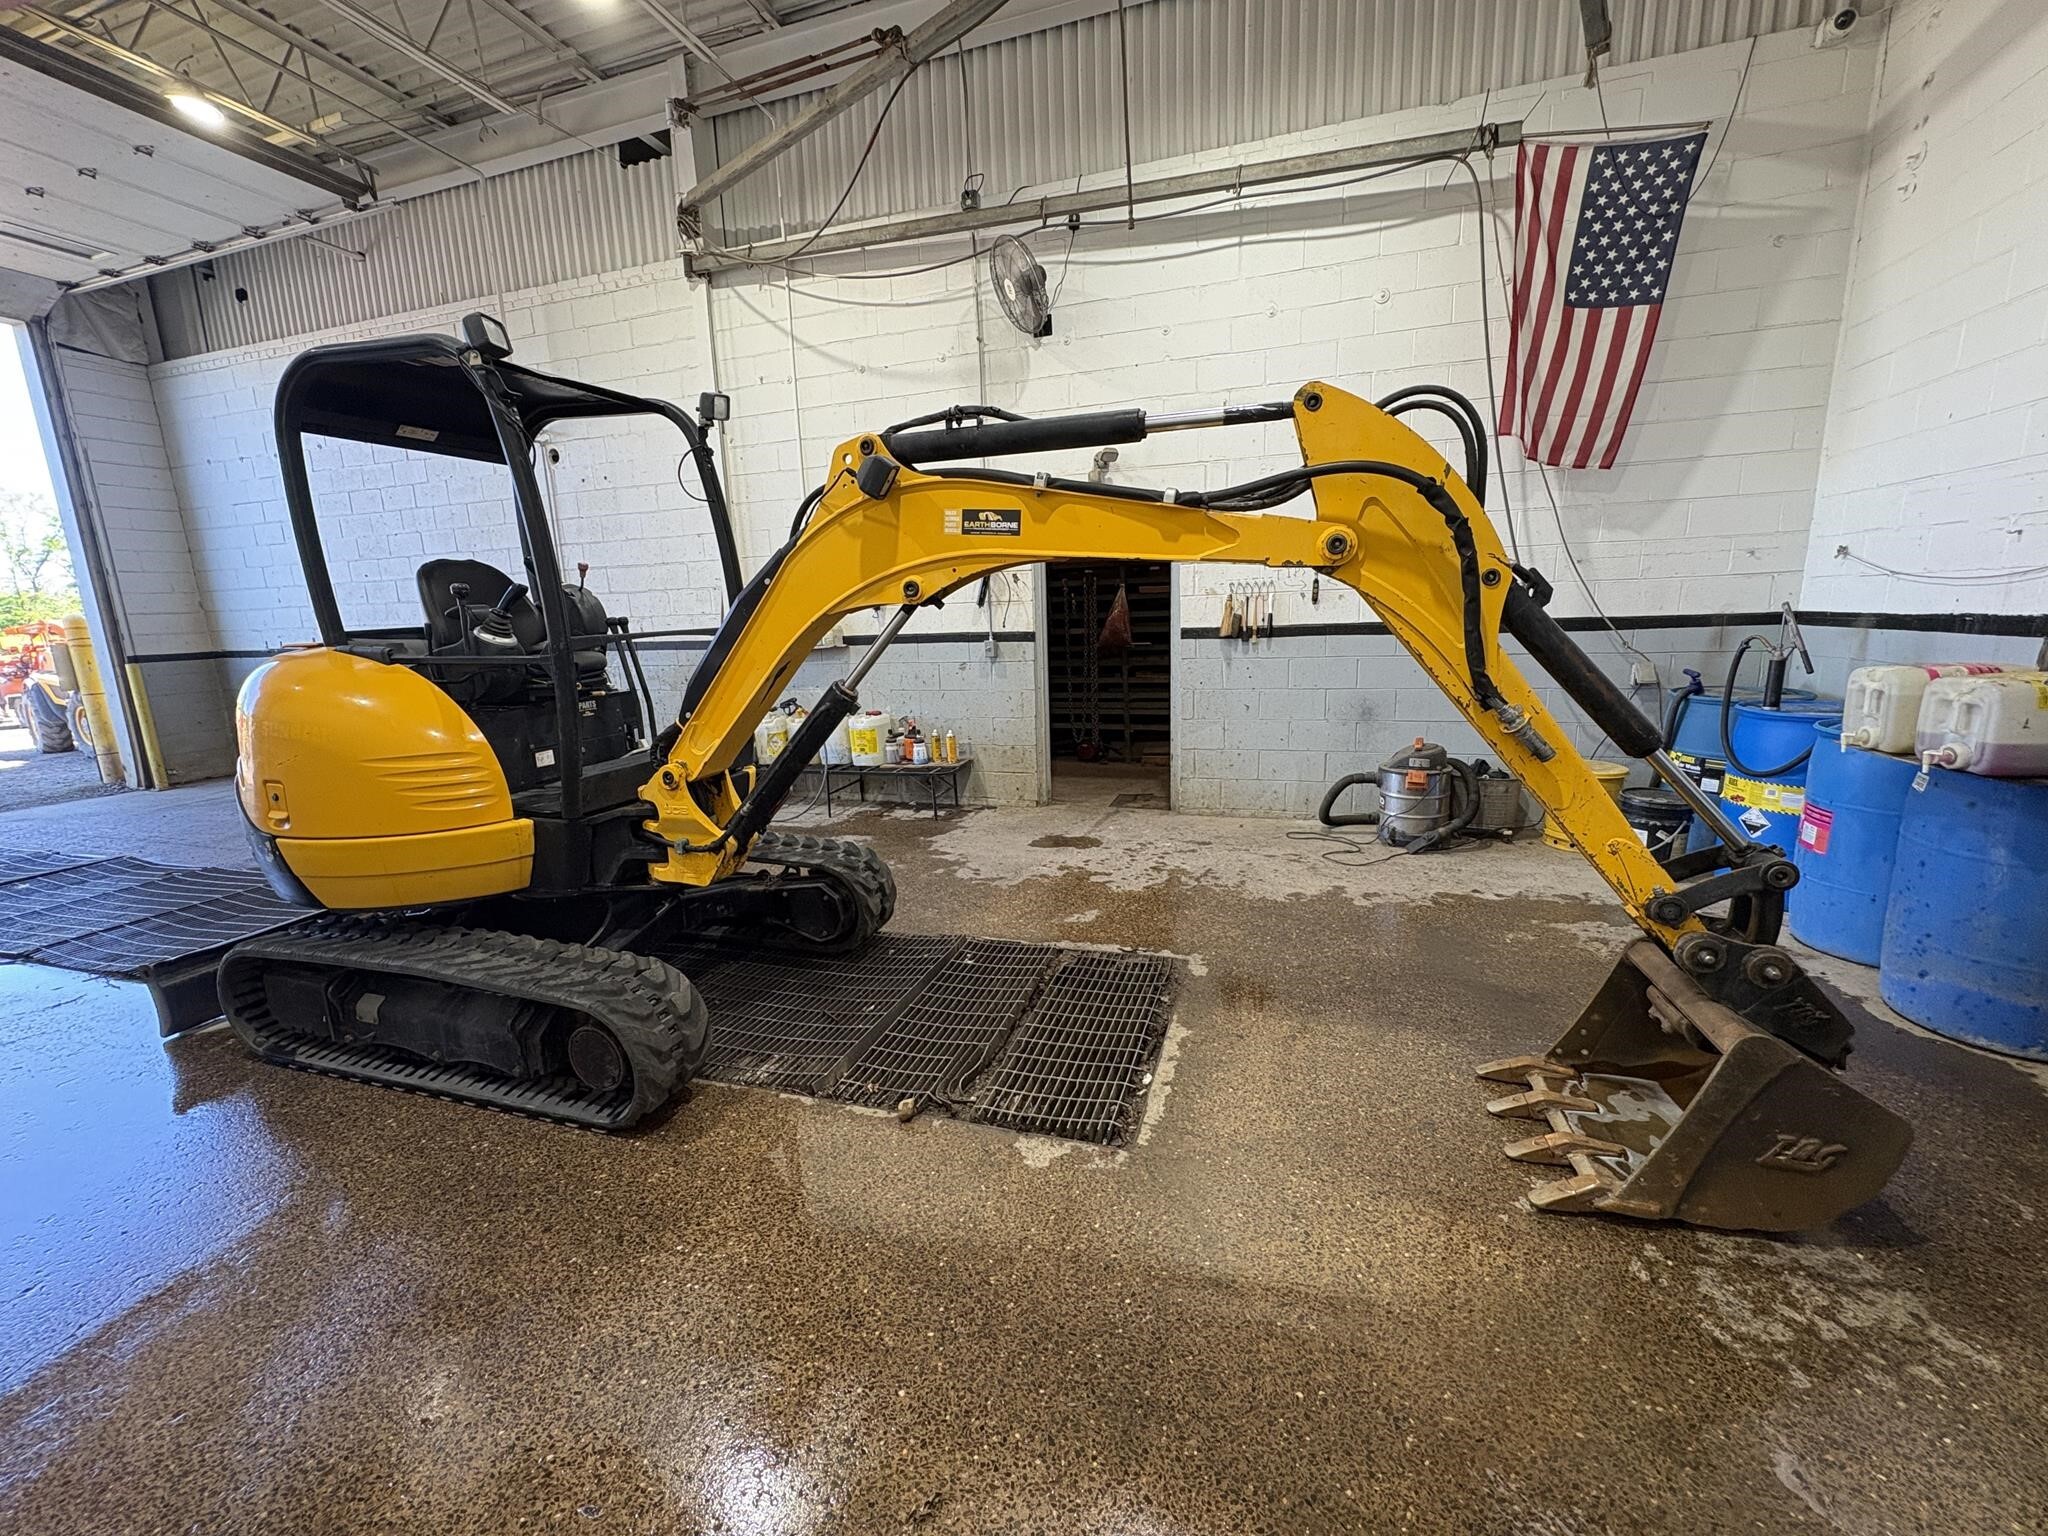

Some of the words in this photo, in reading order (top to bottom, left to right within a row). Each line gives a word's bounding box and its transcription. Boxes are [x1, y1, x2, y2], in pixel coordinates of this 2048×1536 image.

[963, 520, 1019, 529] EARTHBORNE
[578, 700, 597, 709] PARTS
[664, 803, 689, 815] JCB
